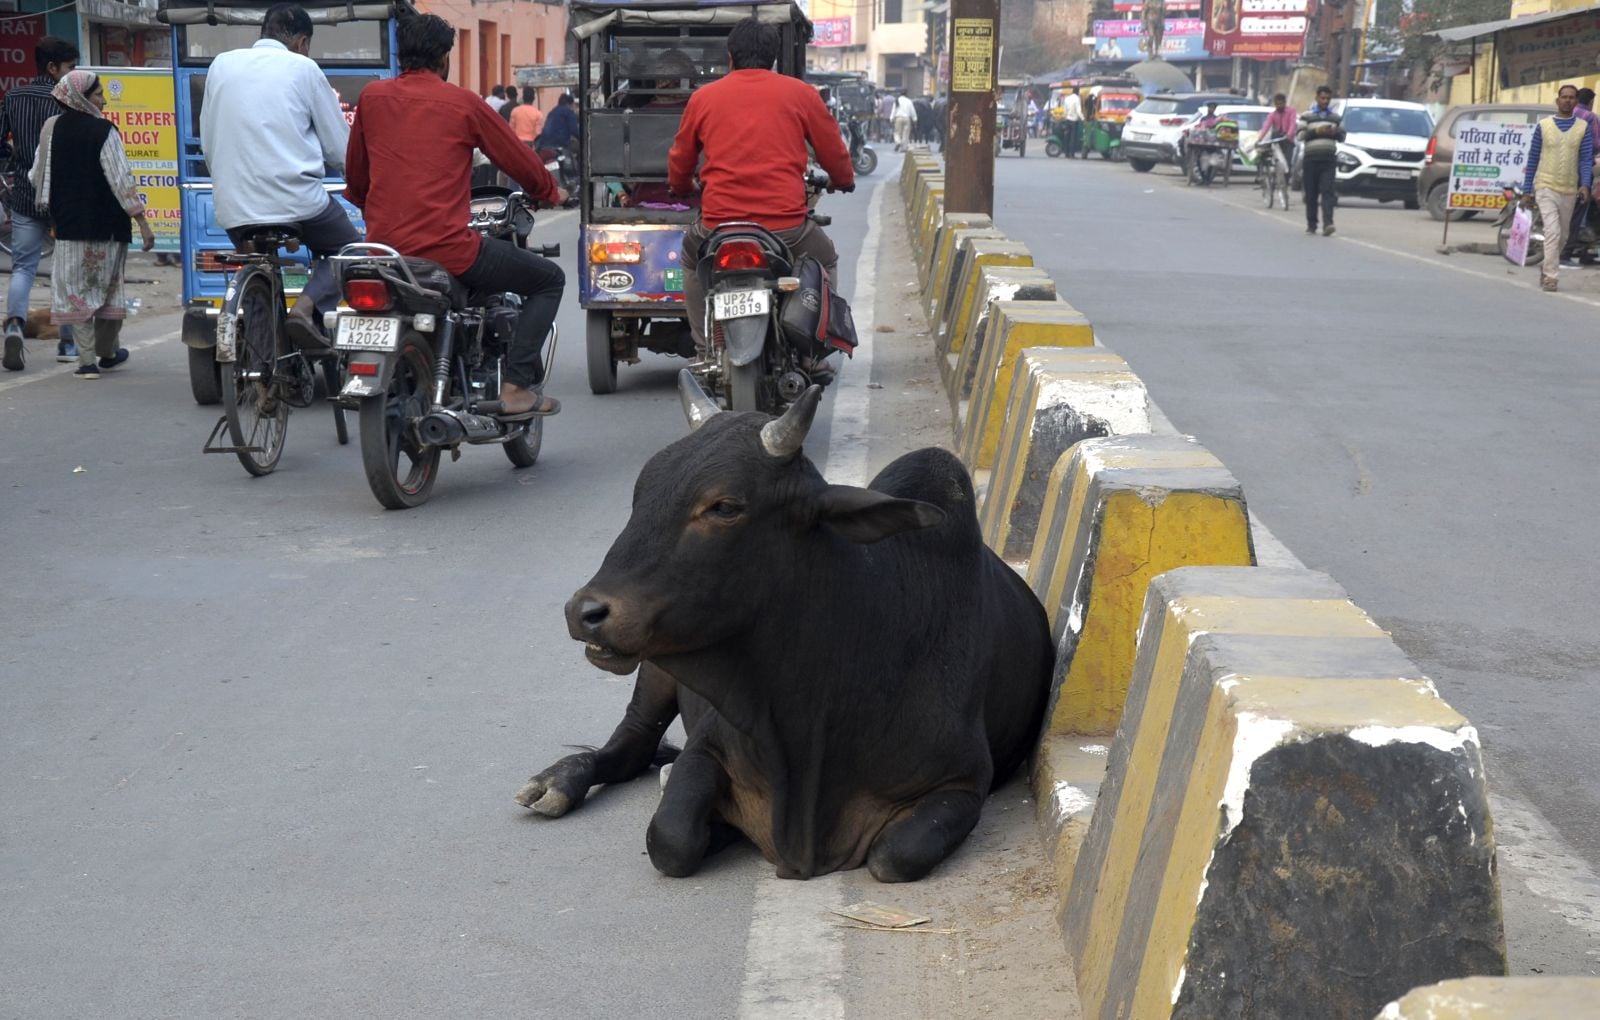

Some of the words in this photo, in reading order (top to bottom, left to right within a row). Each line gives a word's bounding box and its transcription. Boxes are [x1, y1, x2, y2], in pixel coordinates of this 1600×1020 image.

[0, 76, 34, 91] VIC
[155, 161, 174, 169] LAB
[143, 209, 159, 218] GY
[723, 292, 755, 306] UP24
[724, 302, 762, 318] M0919
[349, 318, 391, 332] UP24B
[346, 332, 389, 346] A2024
